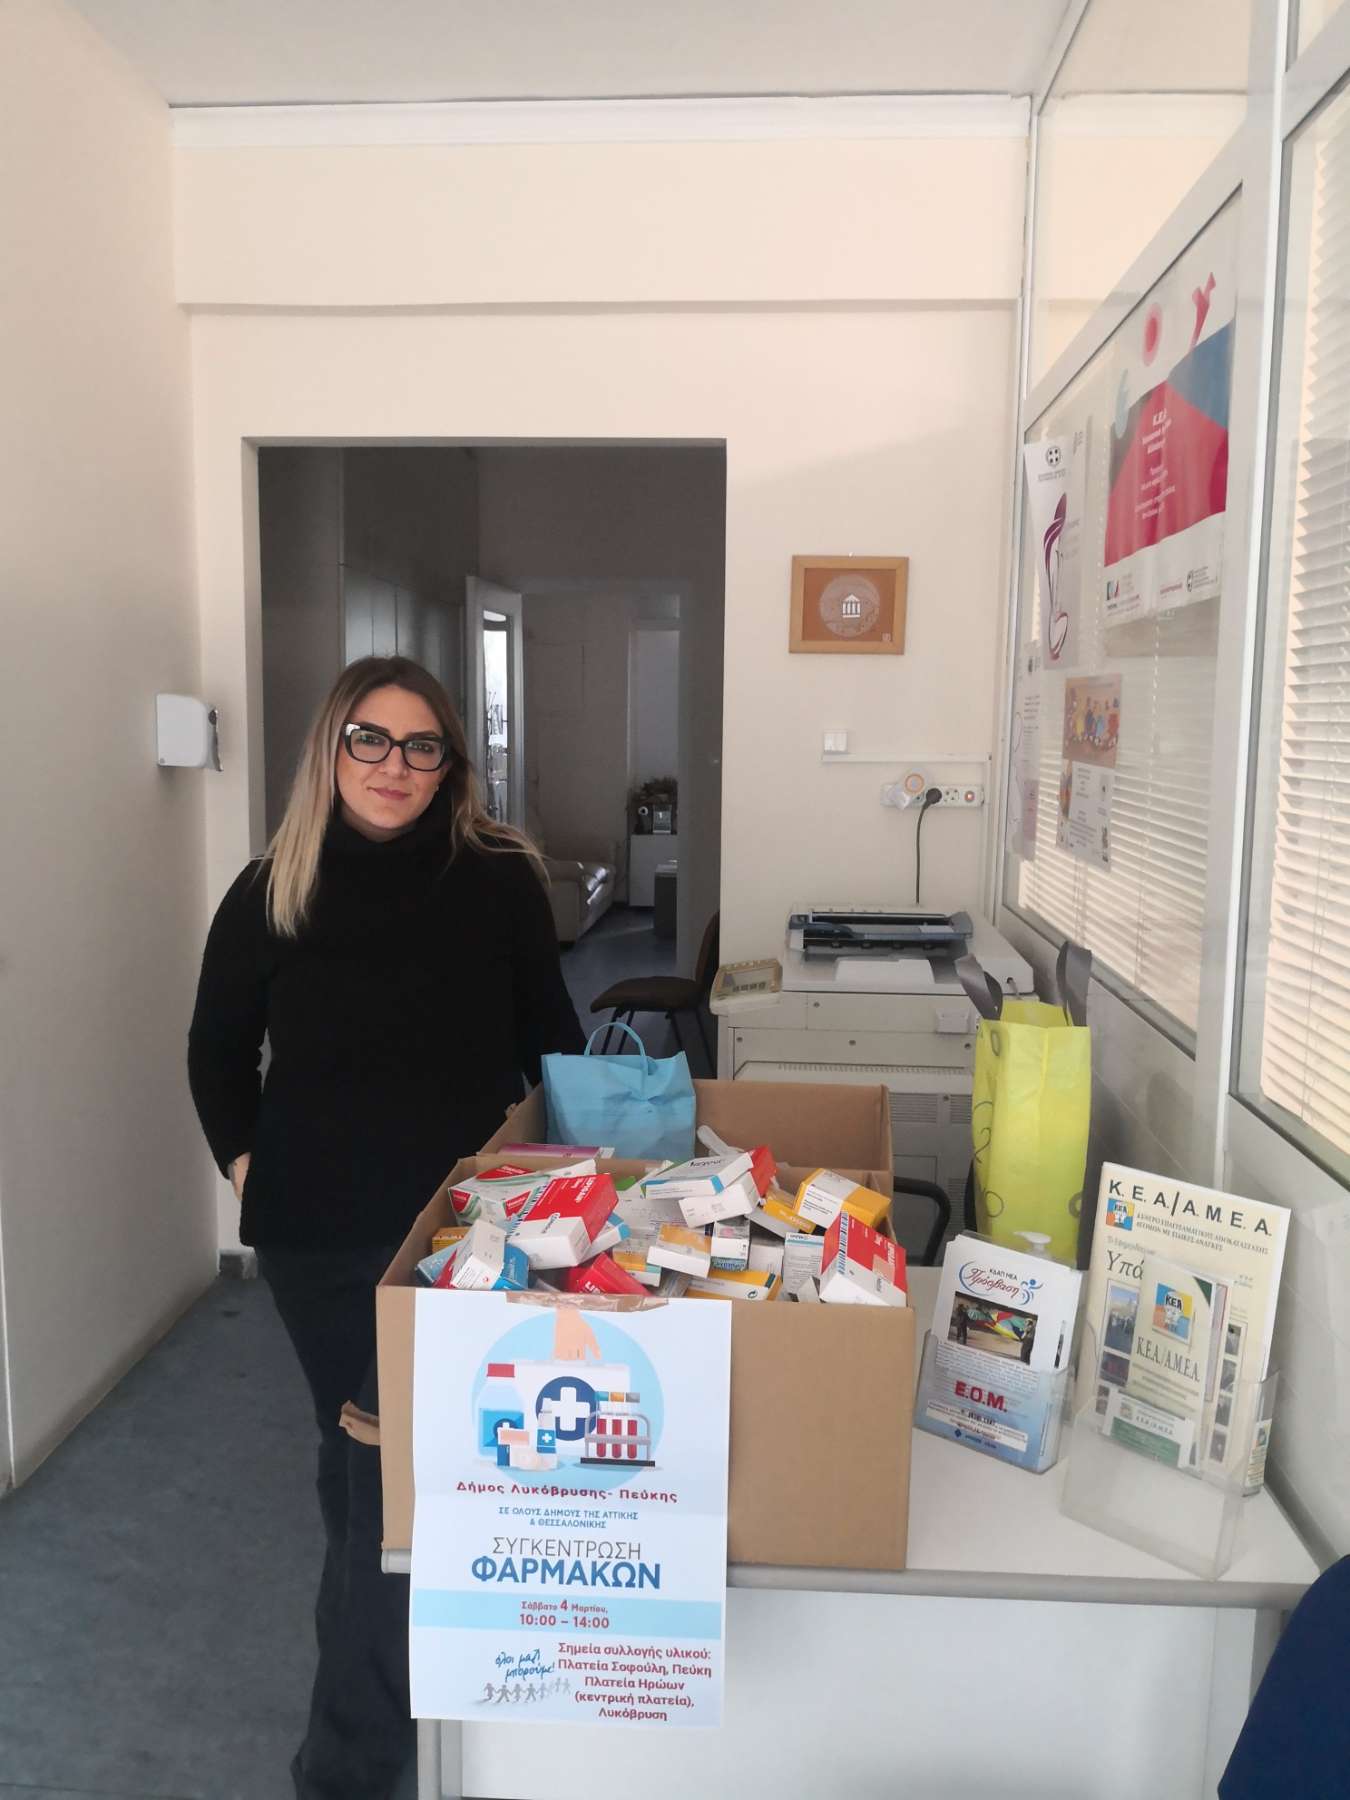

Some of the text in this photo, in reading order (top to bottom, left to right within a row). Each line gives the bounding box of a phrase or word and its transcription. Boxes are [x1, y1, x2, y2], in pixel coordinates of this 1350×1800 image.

[1106, 1250, 1143, 1281] Υπά
[456, 1481, 505, 1494] Δήμος
[619, 1488, 678, 1503] Πεύκης
[498, 1506, 510, 1515] ΣΕ
[544, 1508, 581, 1518] ΔΗΜΟΥΣ
[584, 1510, 601, 1519] ΤΗΣ
[603, 1511, 639, 1520] ΑΤΤΙΚΗΣ
[538, 1519, 607, 1529] ΘΕΣΣΑΛΟΝΙΚΗΣ
[492, 1537, 641, 1560] ΣΥΓΚΕΝΤΡΩΣΗ
[471, 1555, 661, 1590] ΦΑΡΜΑΚΩΝ
[521, 1599, 608, 1614] Σάββατο 4 Μαρτίου,
[519, 1613, 556, 1627] 10:00
[573, 1616, 610, 1629] 14:00
[557, 1642, 712, 1661] Σημεία συλλογής υλικού:
[557, 1659, 712, 1678] Πλατεία Σοφούλη, Πεύκη
[584, 1676, 685, 1693] Πλατεία Ηρώων
[574, 1691, 695, 1707] (κεντρική πλατεία),
[598, 1706, 668, 1721] Λυκόβρυση
